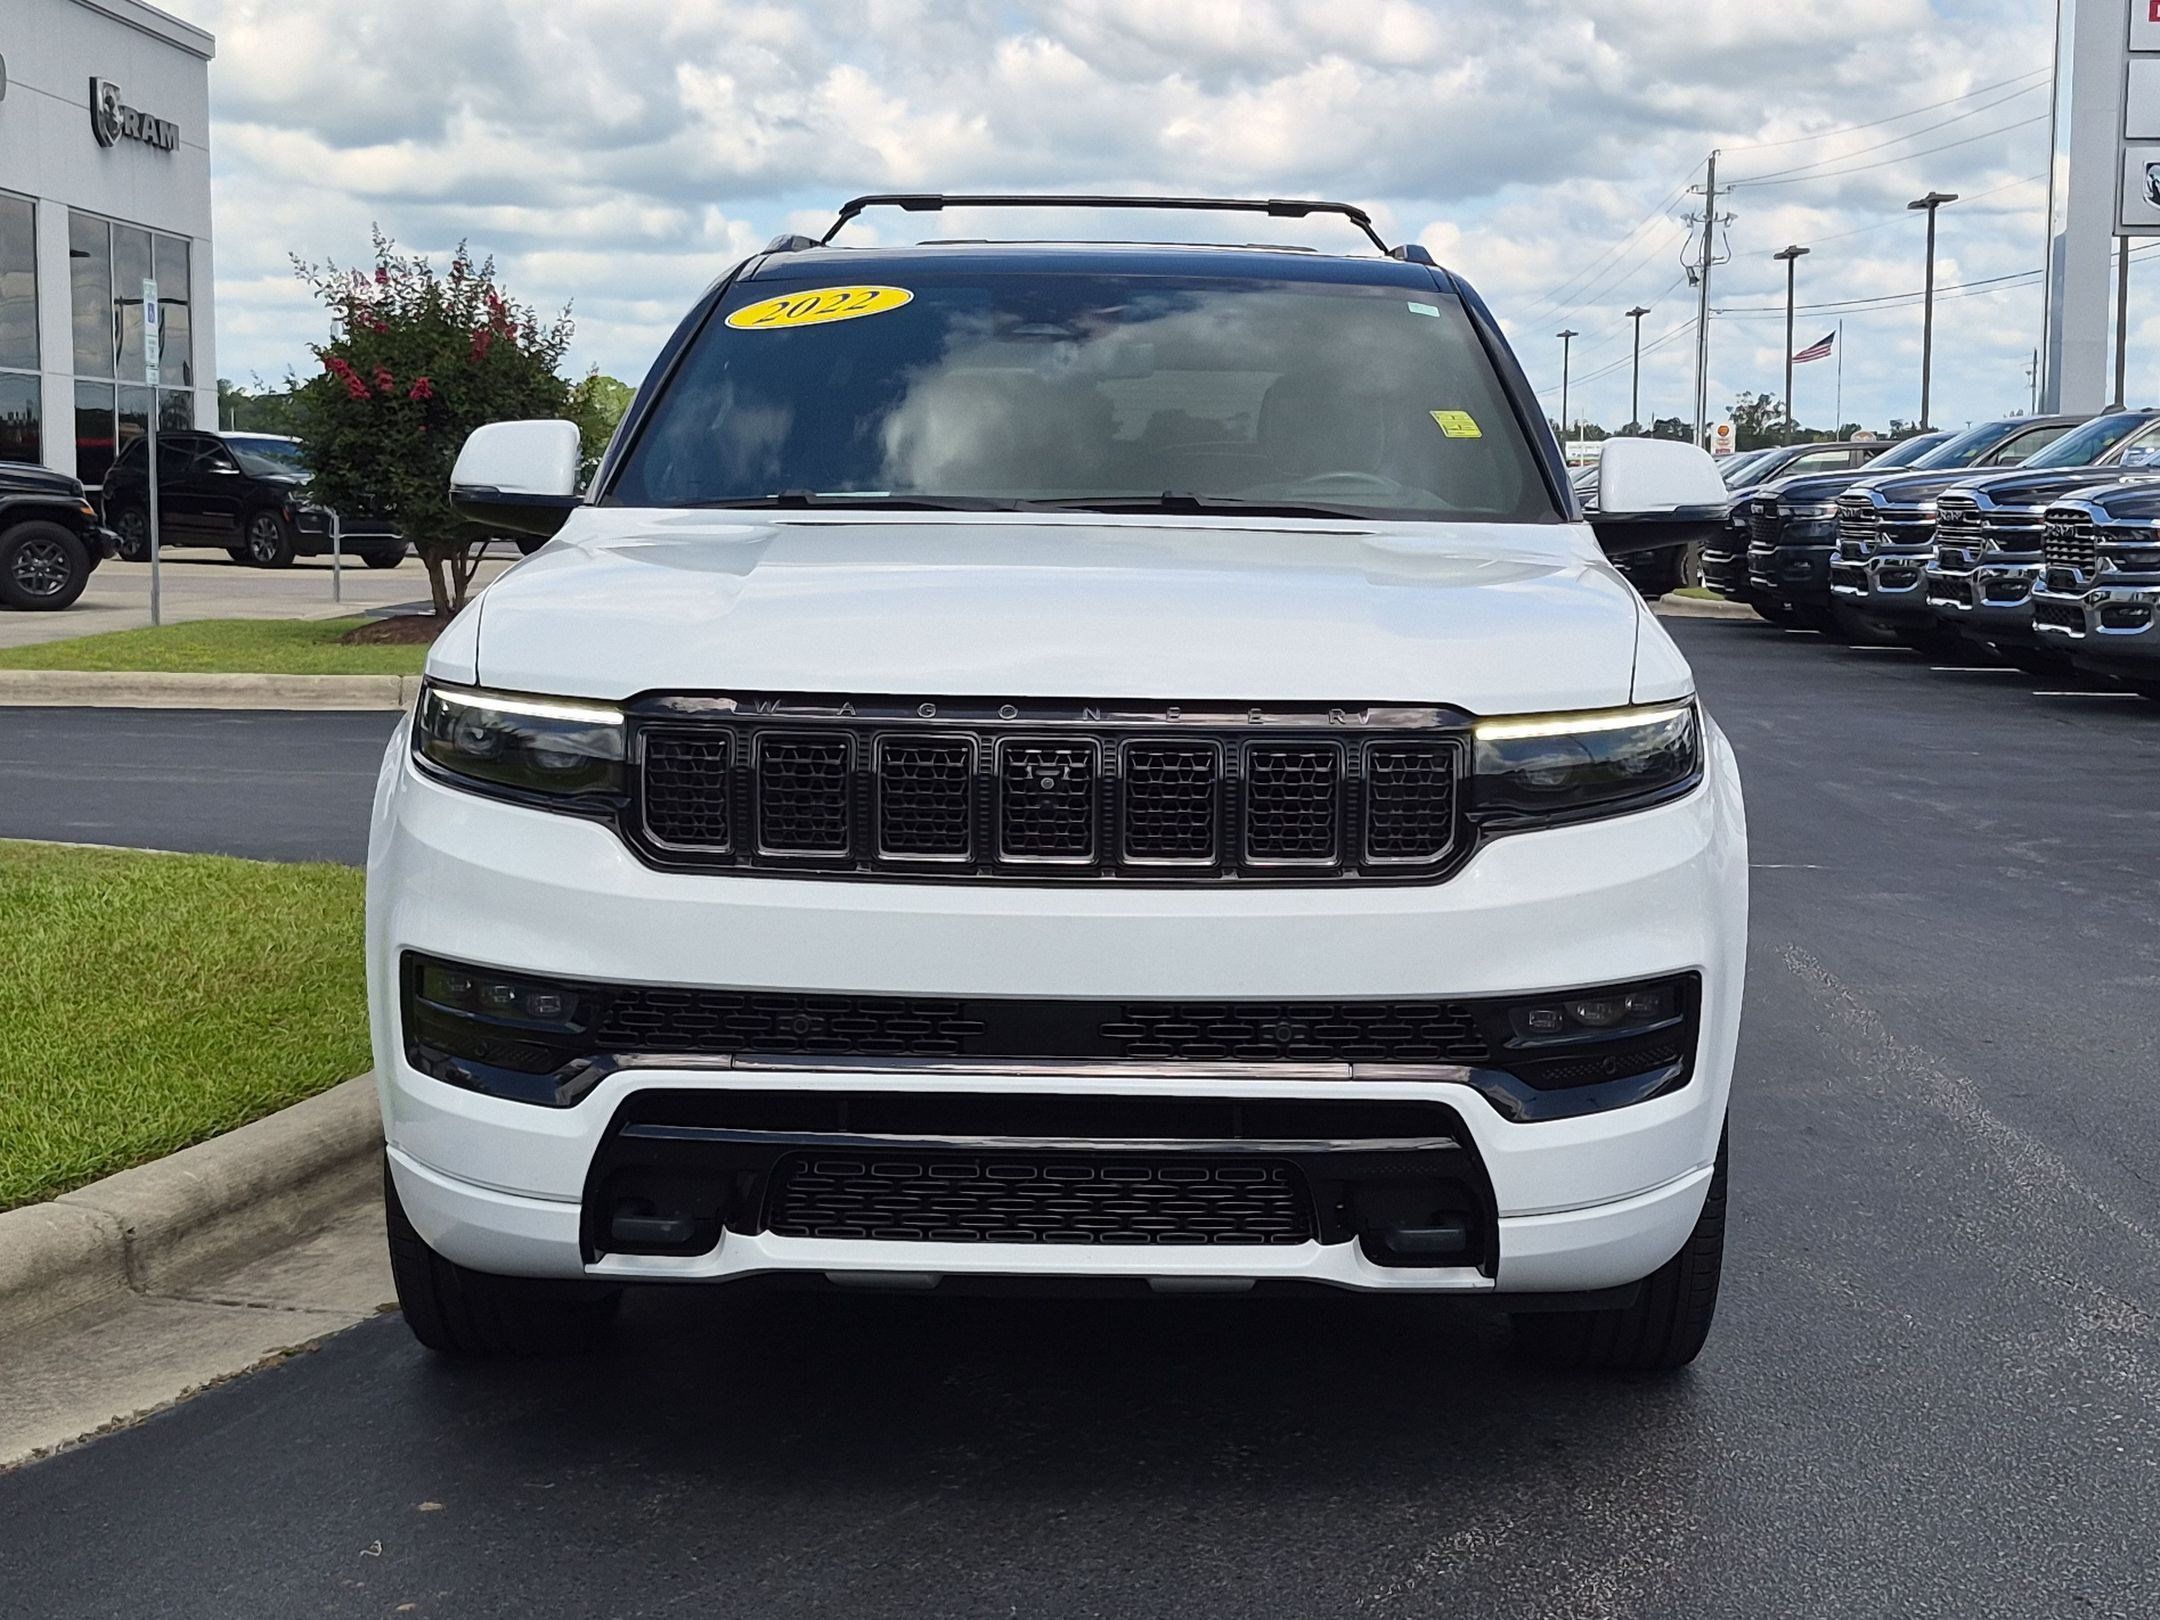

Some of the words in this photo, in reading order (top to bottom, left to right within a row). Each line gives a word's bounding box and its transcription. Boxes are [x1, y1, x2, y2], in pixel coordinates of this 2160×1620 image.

[121, 105, 180, 151] RAM
[752, 291, 880, 325] 2022
[755, 699, 1346, 725] WAGONEER
